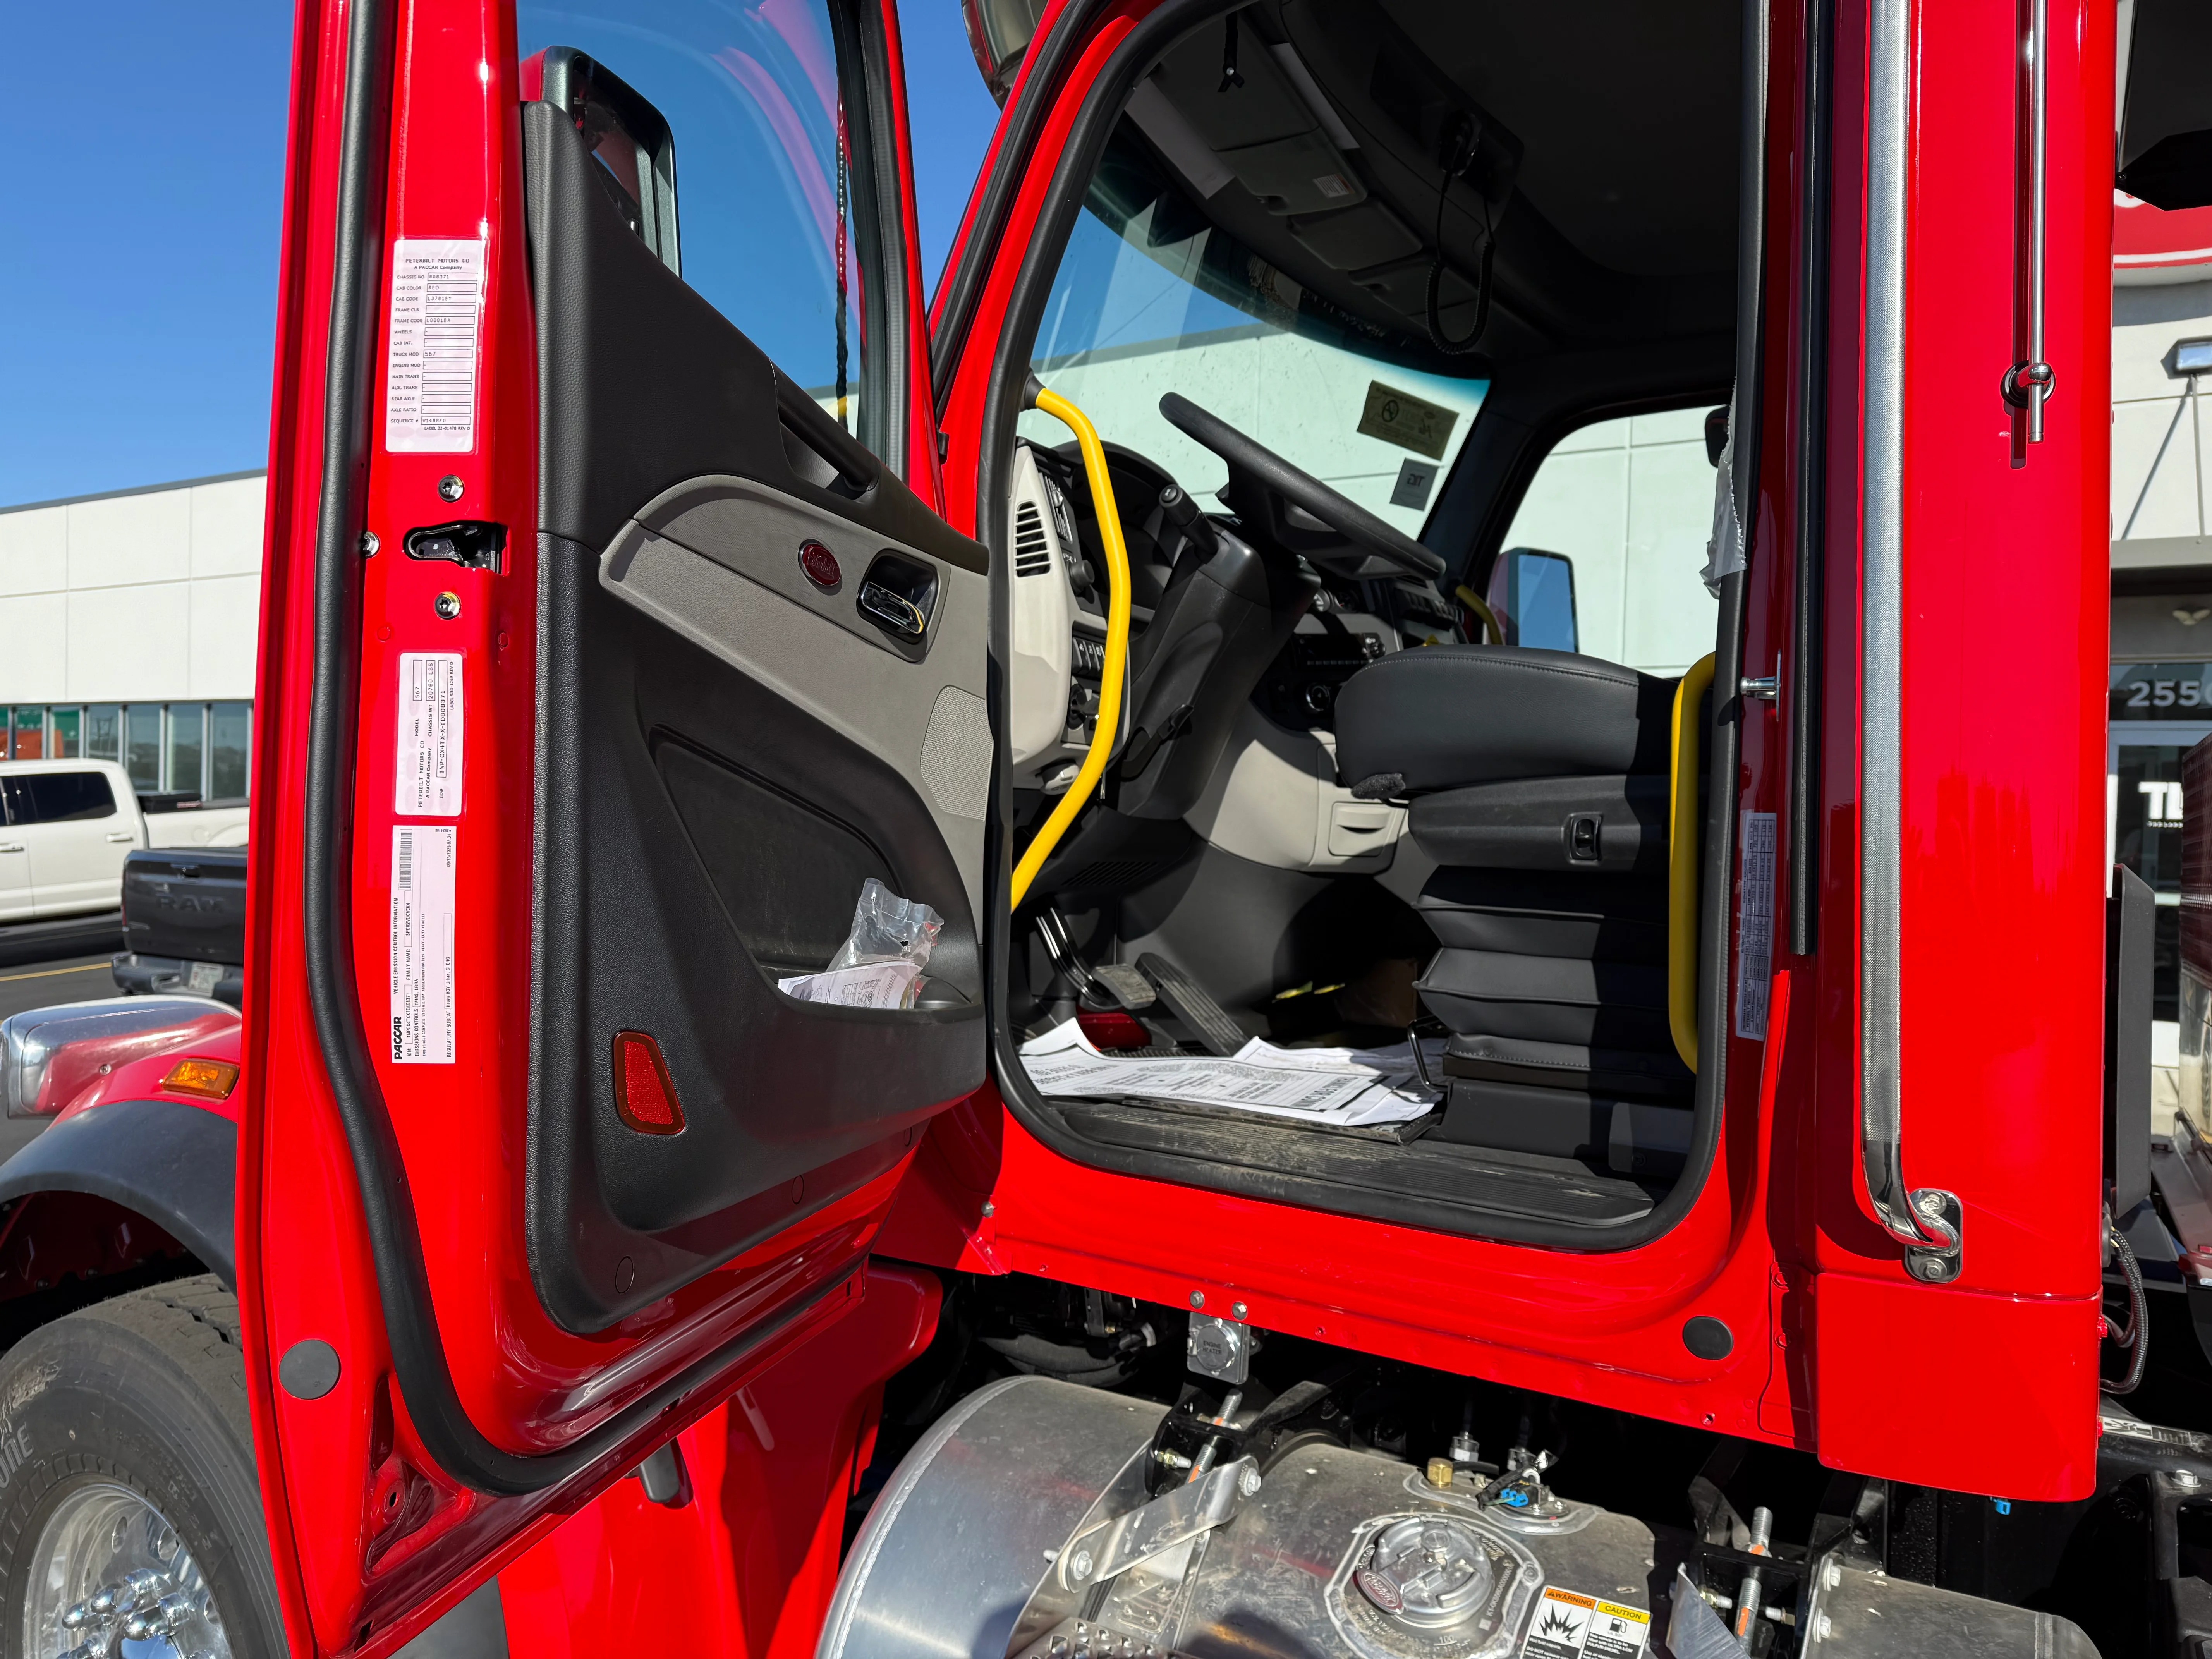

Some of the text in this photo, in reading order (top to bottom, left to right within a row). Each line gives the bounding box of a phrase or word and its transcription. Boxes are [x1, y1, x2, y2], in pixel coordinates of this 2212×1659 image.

[156, 893, 224, 914] RAM
[393, 1016, 402, 1060] PACCAR
[1203, 1340, 1222, 1349] ENGINE
[1556, 1593, 1592, 1606] WARNING
[1605, 1606, 1642, 1620] CAUTION
[1439, 1635, 1455, 1644] 100
[1587, 1641, 1604, 1649] SULFUR
